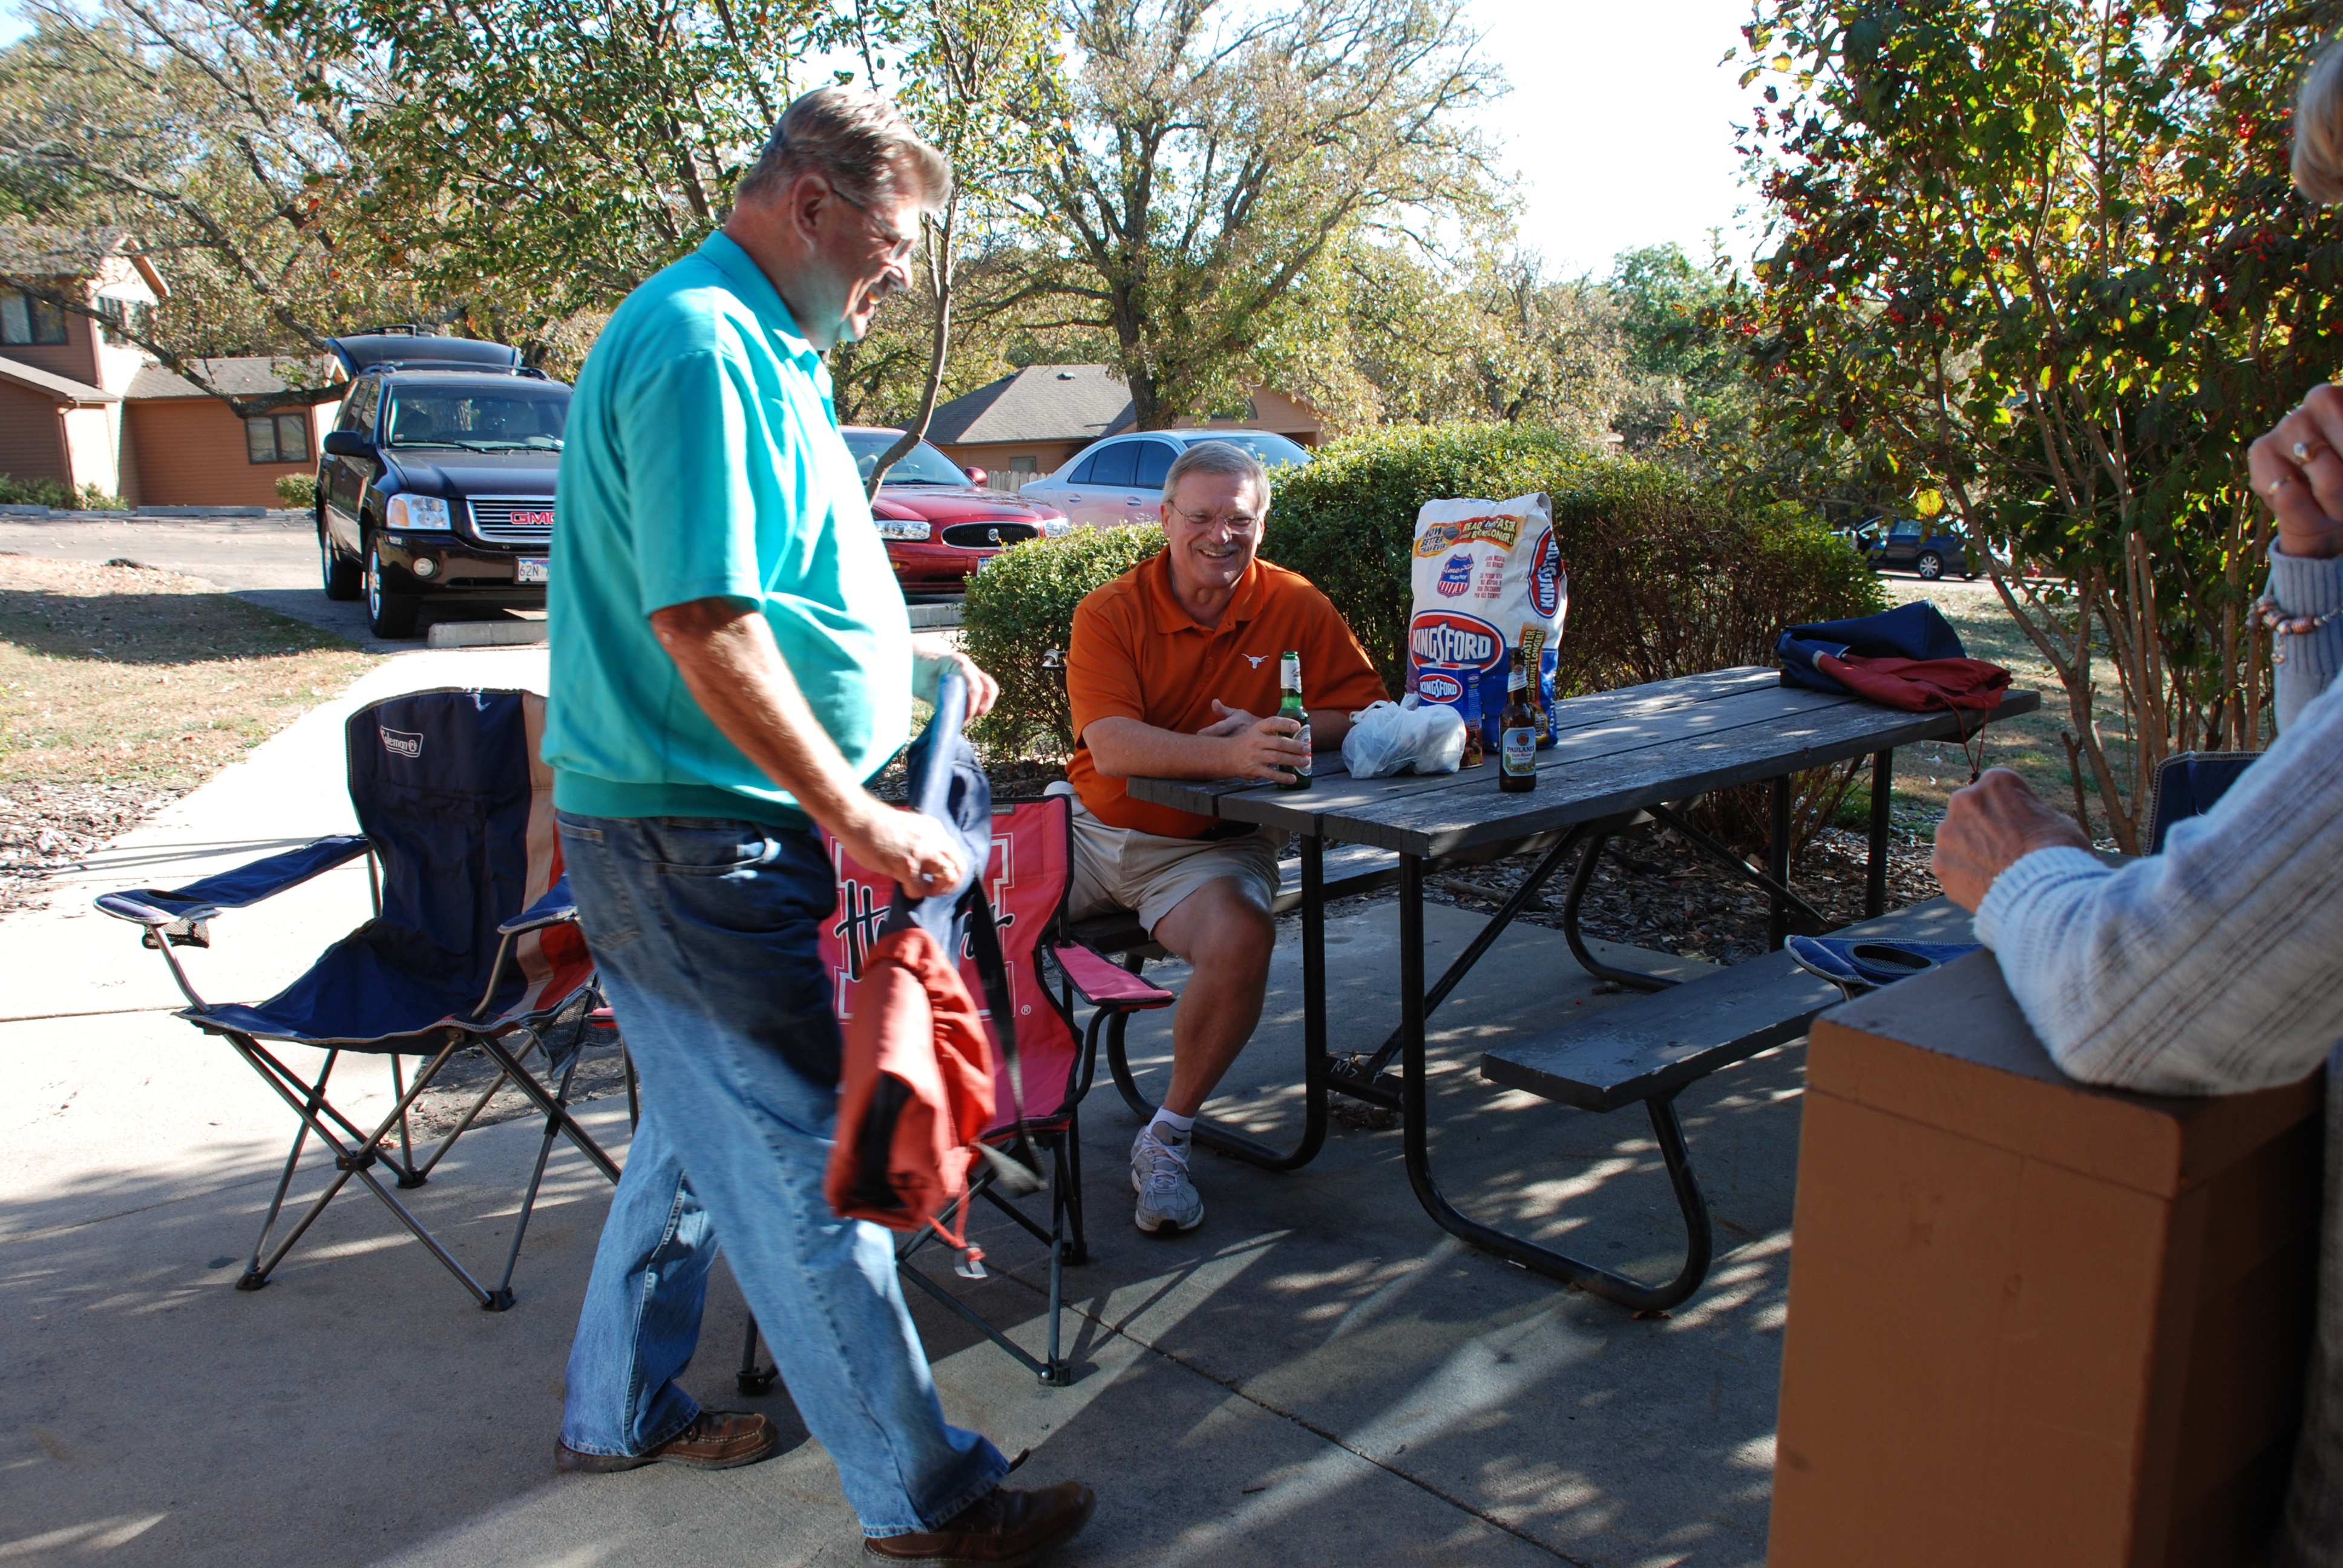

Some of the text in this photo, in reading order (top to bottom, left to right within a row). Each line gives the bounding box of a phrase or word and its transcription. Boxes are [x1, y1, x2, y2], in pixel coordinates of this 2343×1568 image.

[1412, 622, 1491, 664] KINGSFORD
[1531, 630, 1545, 662] LONGER!
[1420, 678, 1457, 698] KINGSFORD
